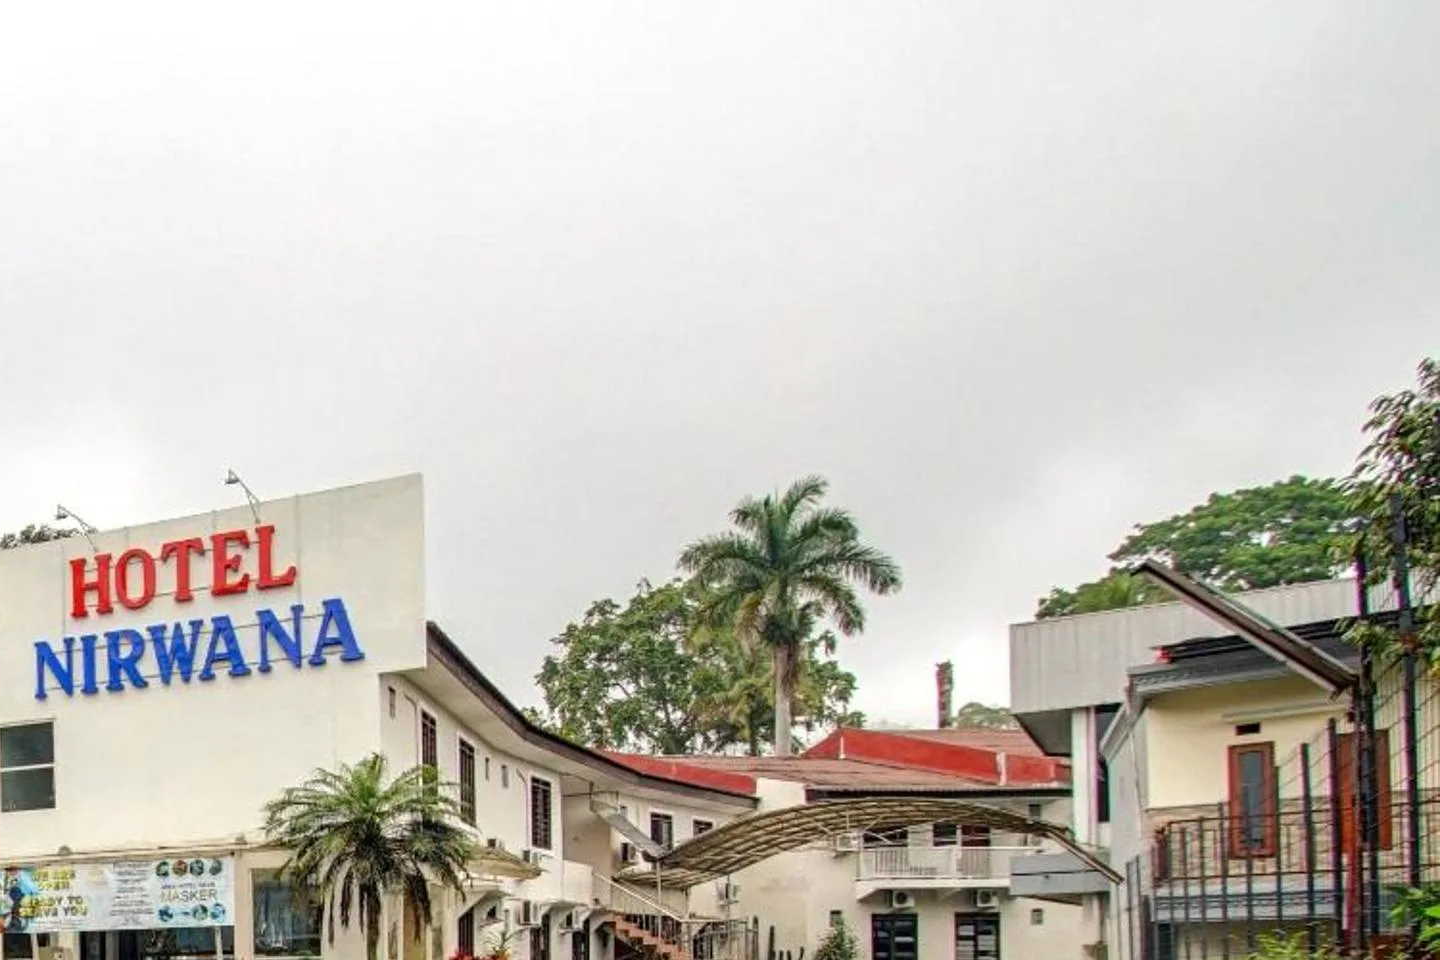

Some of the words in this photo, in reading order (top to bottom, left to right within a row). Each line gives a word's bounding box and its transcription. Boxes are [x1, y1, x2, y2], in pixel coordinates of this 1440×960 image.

[69, 524, 297, 618] HOTEL
[34, 598, 365, 700] NIRWANA
[63, 905, 88, 917] YOU
[160, 889, 218, 903] MASKER
